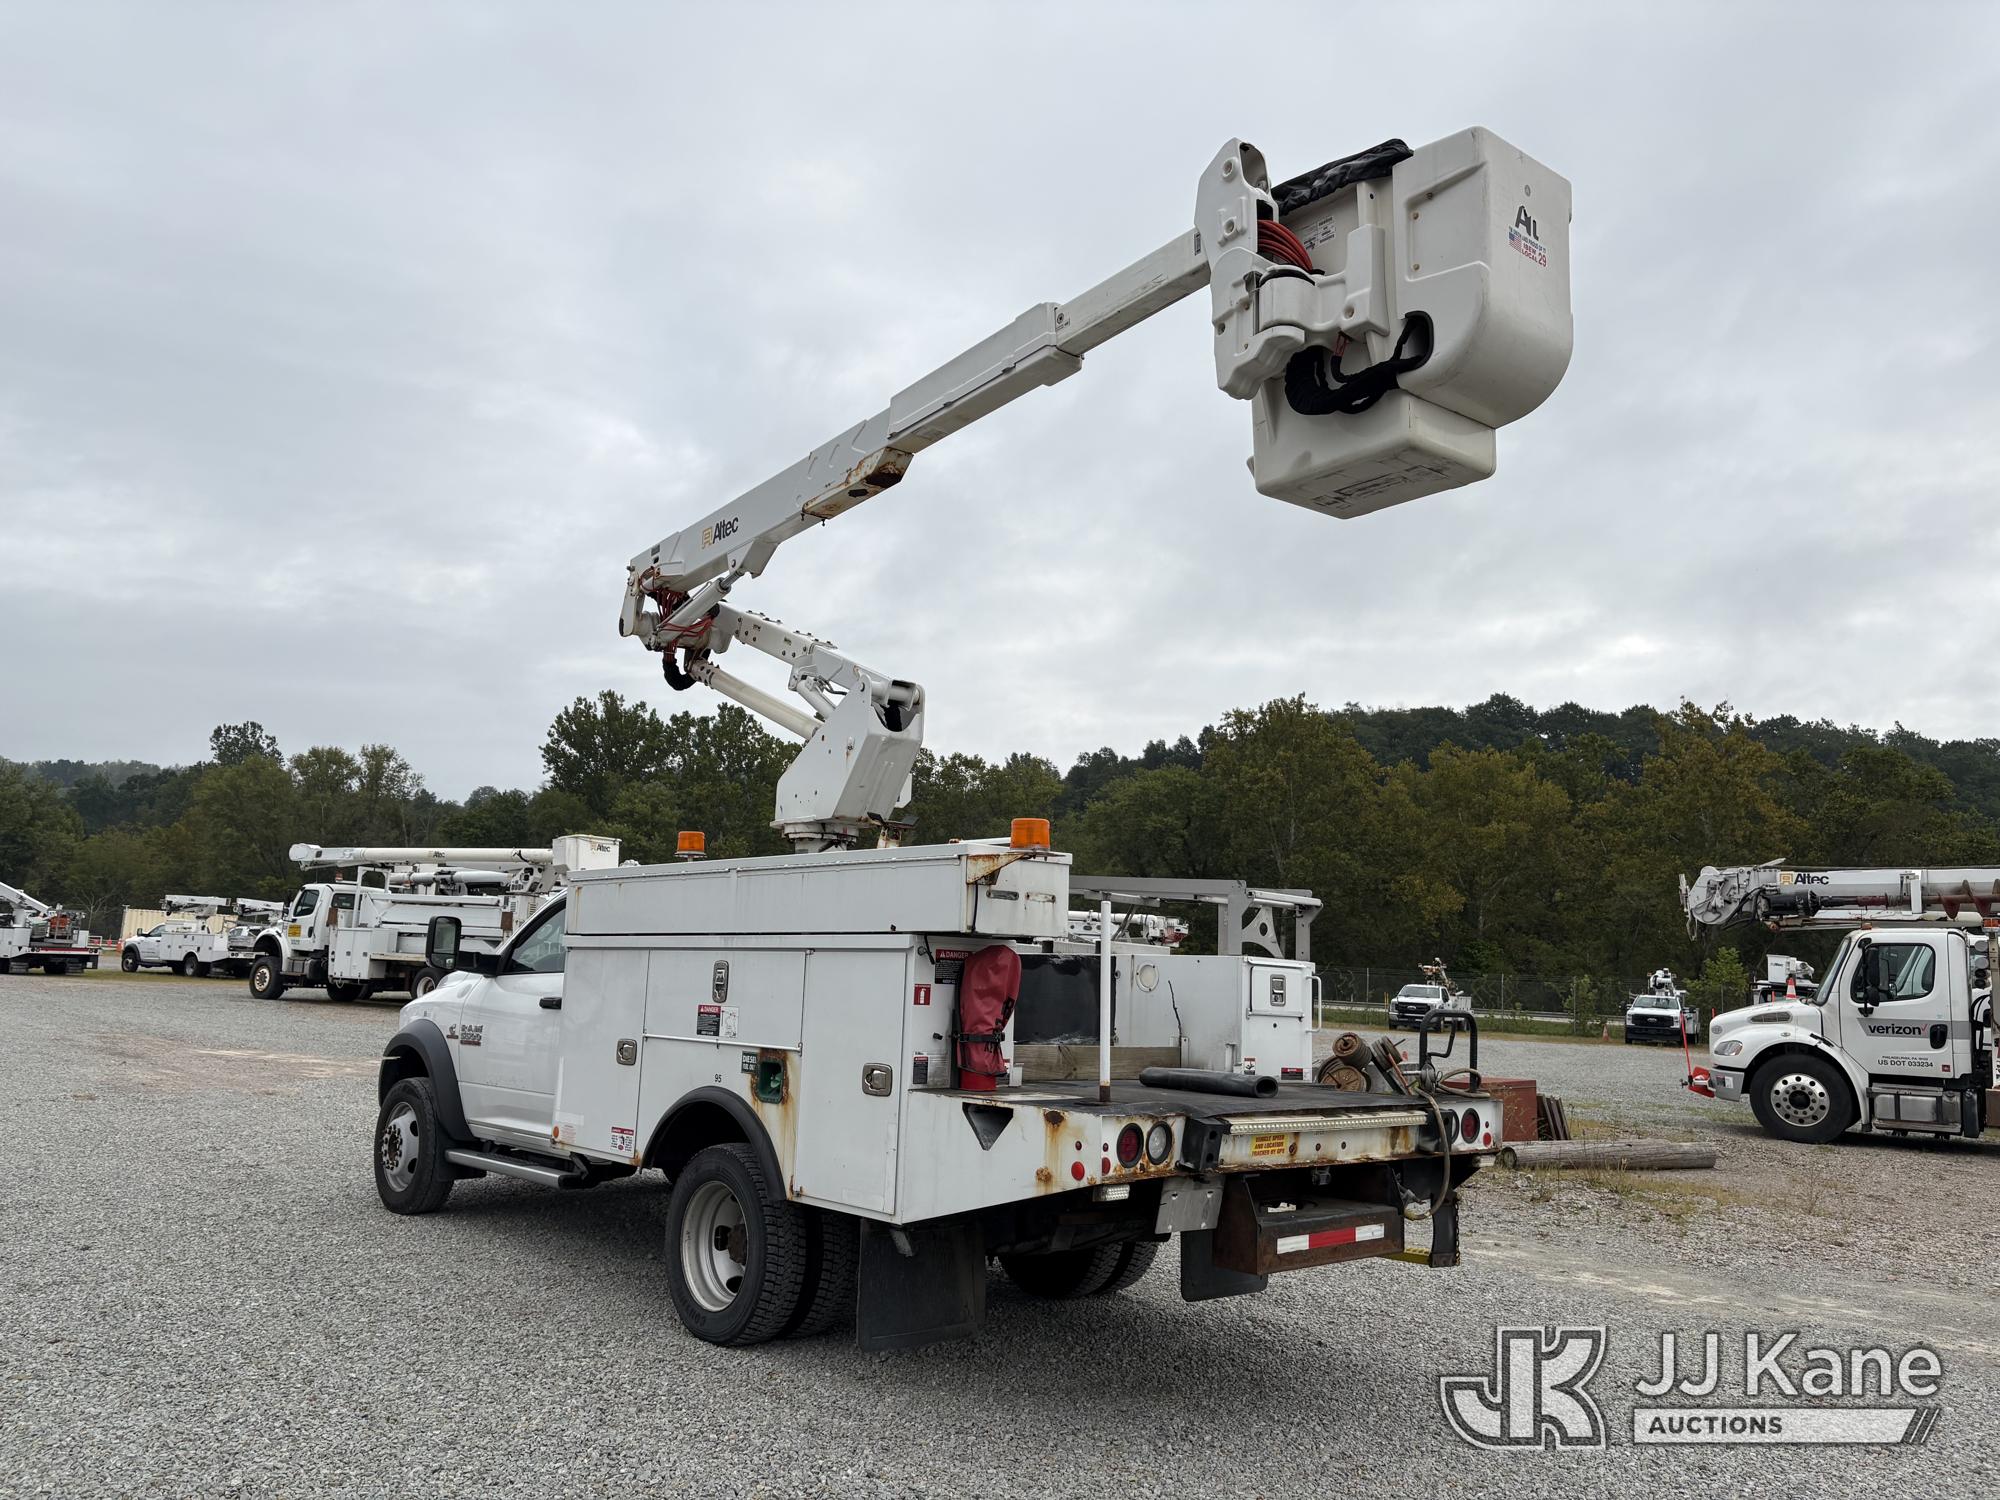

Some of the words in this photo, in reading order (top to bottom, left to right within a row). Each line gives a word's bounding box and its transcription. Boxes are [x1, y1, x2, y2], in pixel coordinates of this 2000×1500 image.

[1521, 248, 1538, 263] LOCAL
[1538, 252, 1547, 268] 29
[712, 516, 739, 544] Altec
[1793, 873, 1830, 885] Altec
[945, 950, 969, 959] DANGER
[1868, 1023, 1922, 1036] verizon
[742, 1055, 757, 1063] DIESEL
[714, 1073, 722, 1083] 95
